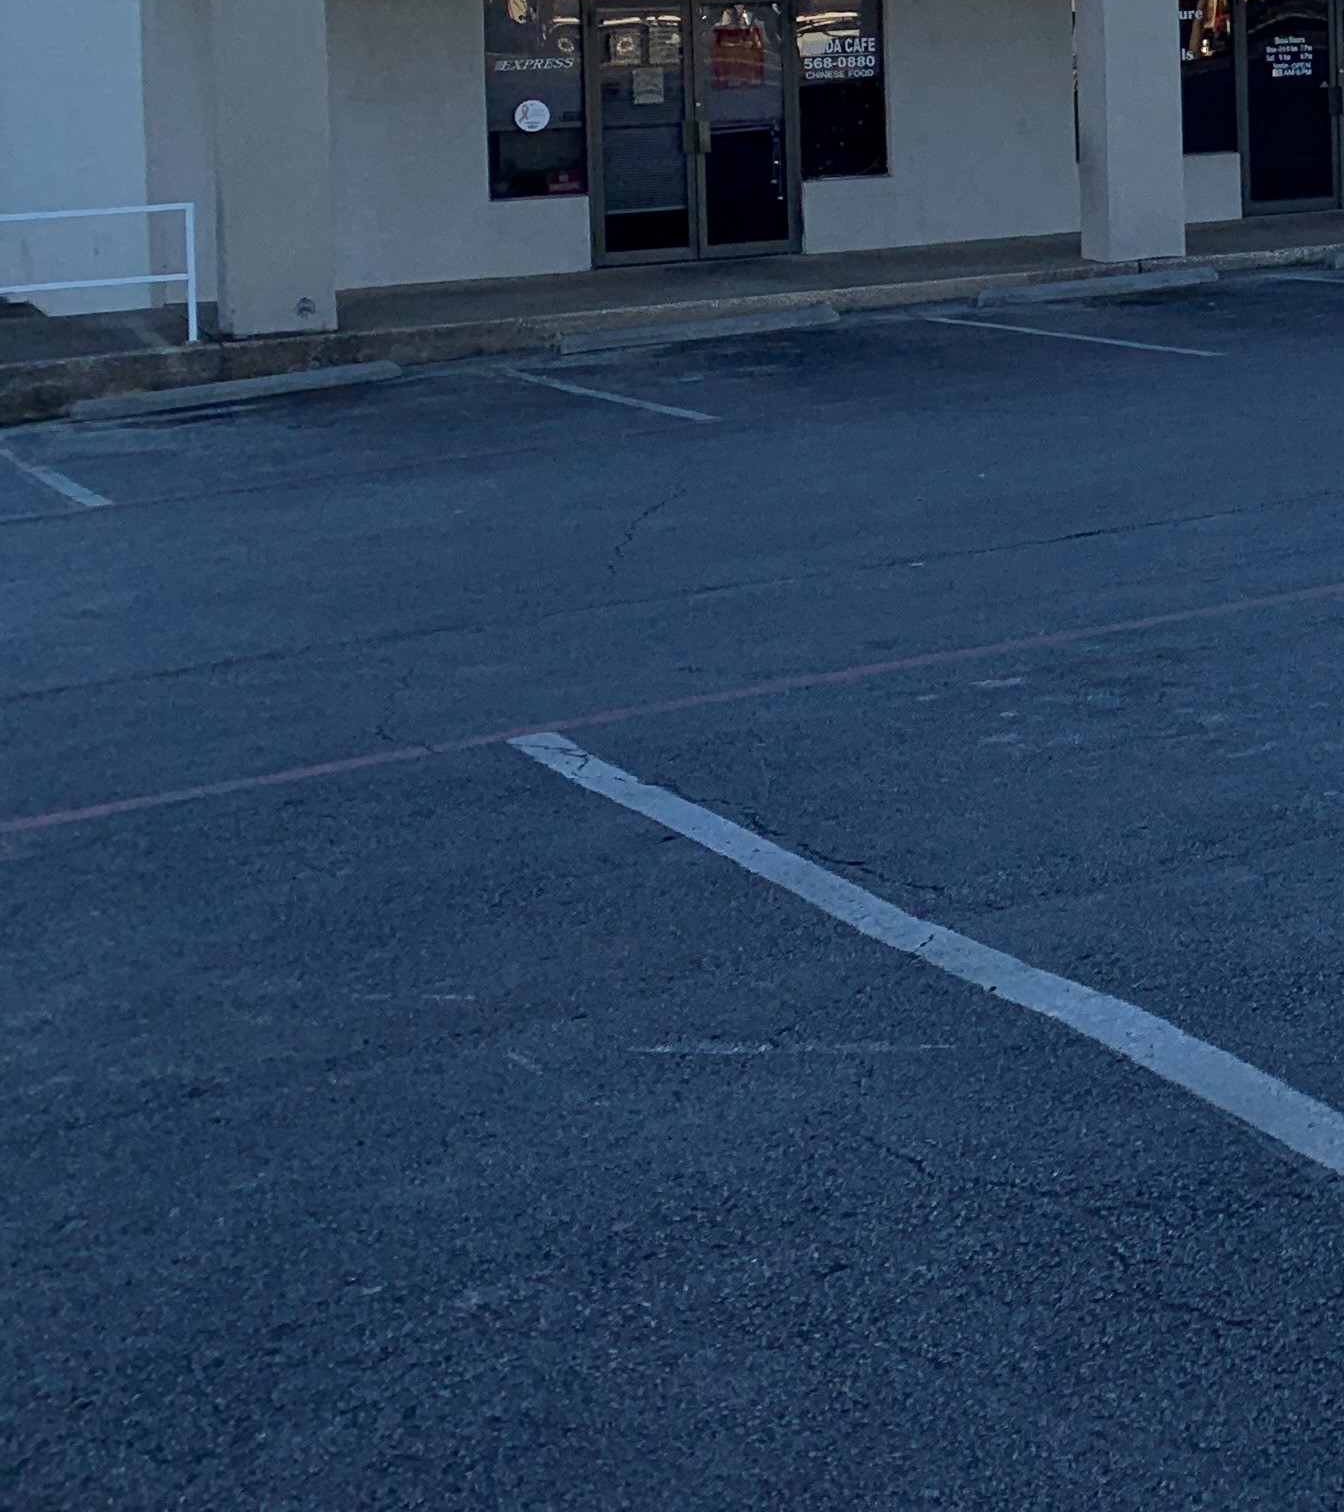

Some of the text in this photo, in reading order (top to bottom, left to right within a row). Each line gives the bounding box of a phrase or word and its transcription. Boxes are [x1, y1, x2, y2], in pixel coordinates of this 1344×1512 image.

[844, 37, 876, 53] CAFE
[803, 55, 876, 70] 568-0880
[805, 69, 875, 80] CHINESE FOOD
